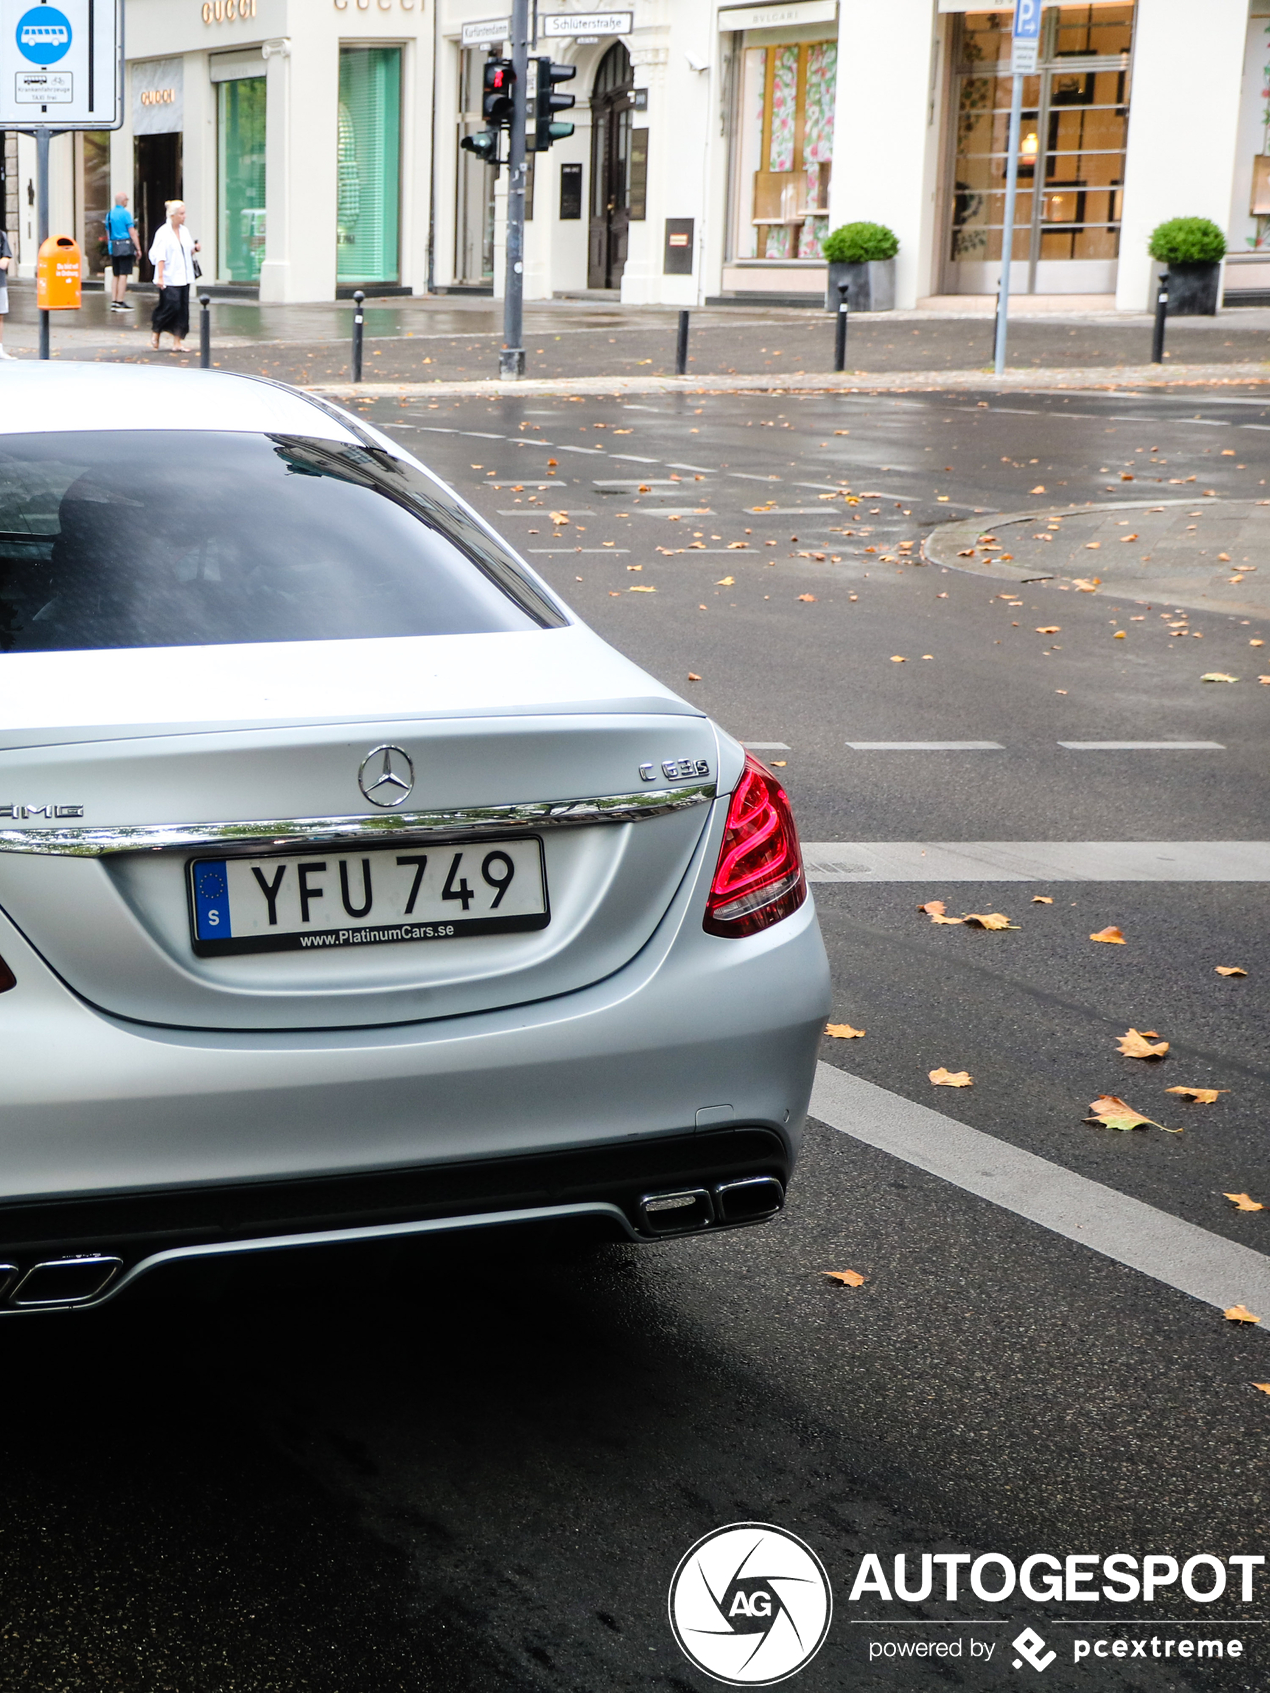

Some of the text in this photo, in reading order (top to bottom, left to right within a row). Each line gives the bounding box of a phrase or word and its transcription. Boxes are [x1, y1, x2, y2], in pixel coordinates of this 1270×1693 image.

[201, 0, 256, 24] GUCCI
[752, 10, 798, 23] BVLGARI
[1017, 0, 1034, 33] P
[553, 16, 622, 30] Schlüterstraße
[141, 88, 175, 105] GUCCI
[638, 763, 657, 782] C
[250, 849, 516, 926] YFU 749
[208, 909, 220, 926] S
[299, 924, 455, 948] www.PlatinumCars.se
